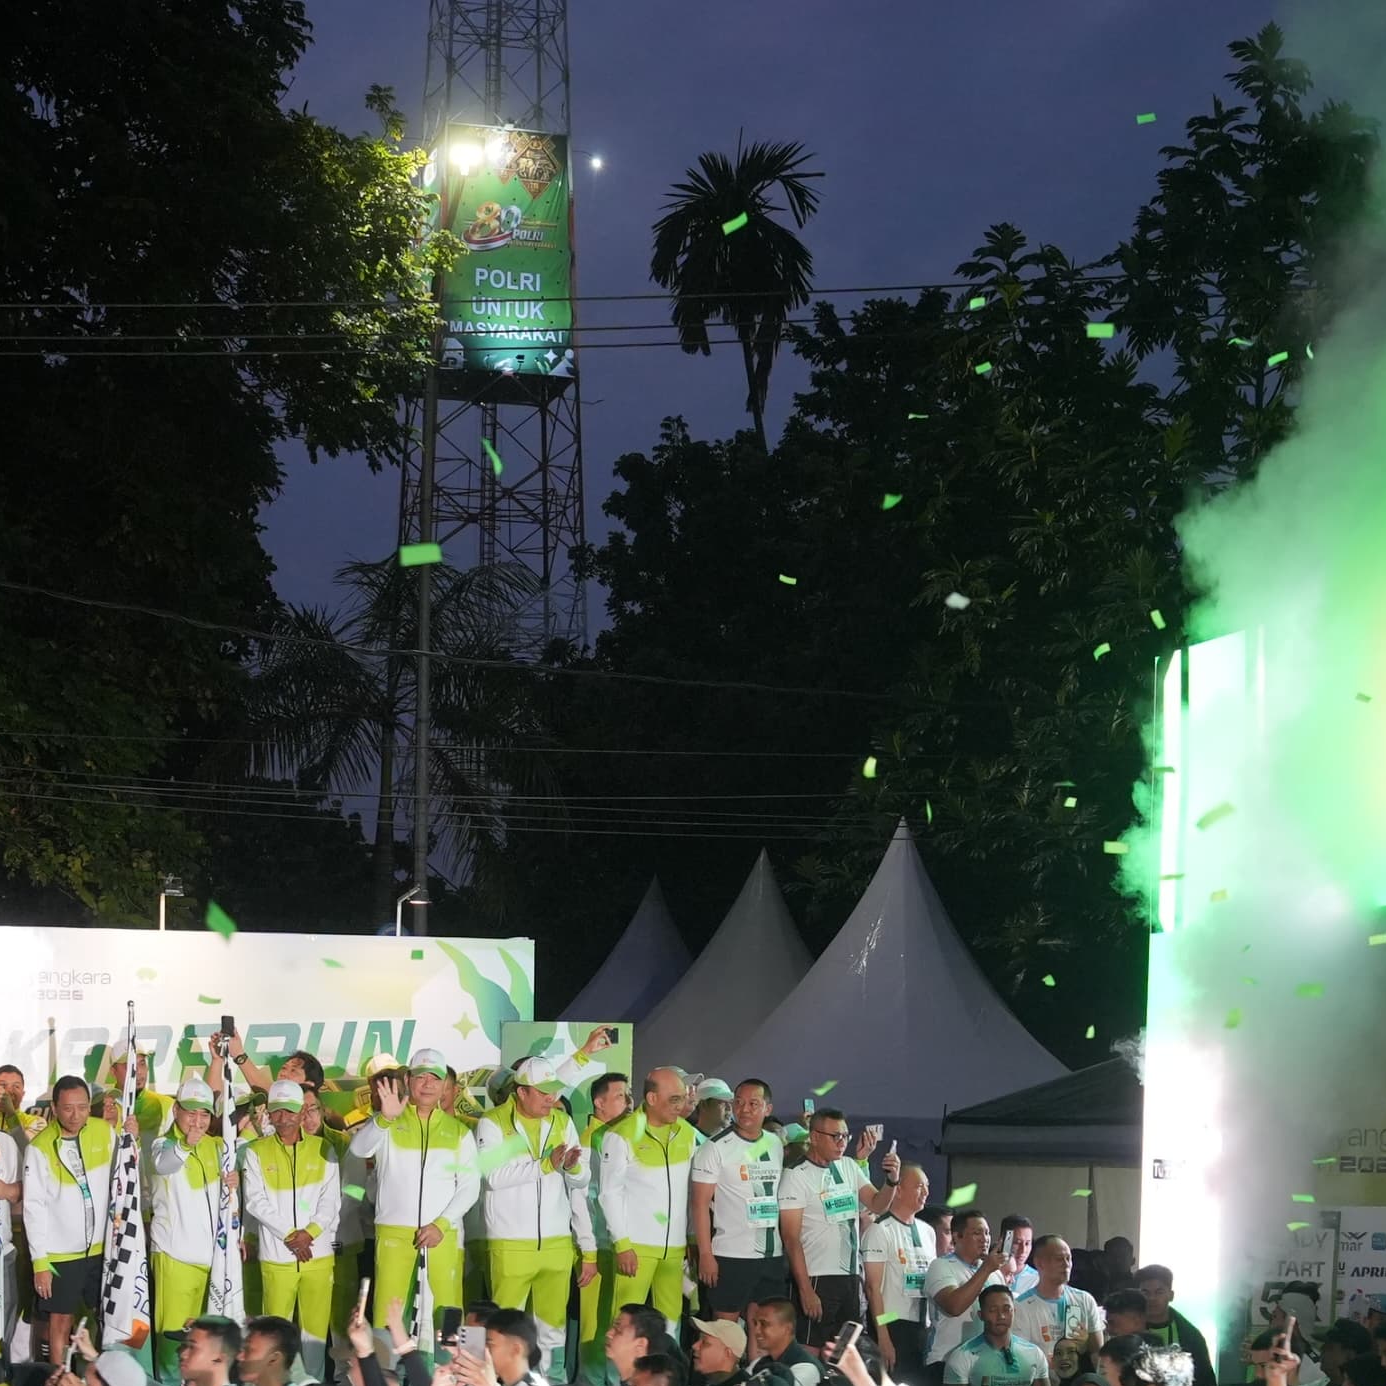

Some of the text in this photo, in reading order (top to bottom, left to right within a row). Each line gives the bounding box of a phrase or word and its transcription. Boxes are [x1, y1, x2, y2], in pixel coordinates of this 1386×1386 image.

[475, 267, 541, 292] POLRI
[471, 296, 545, 321] UNTUK
[447, 319, 566, 344] MASYARAKAT
